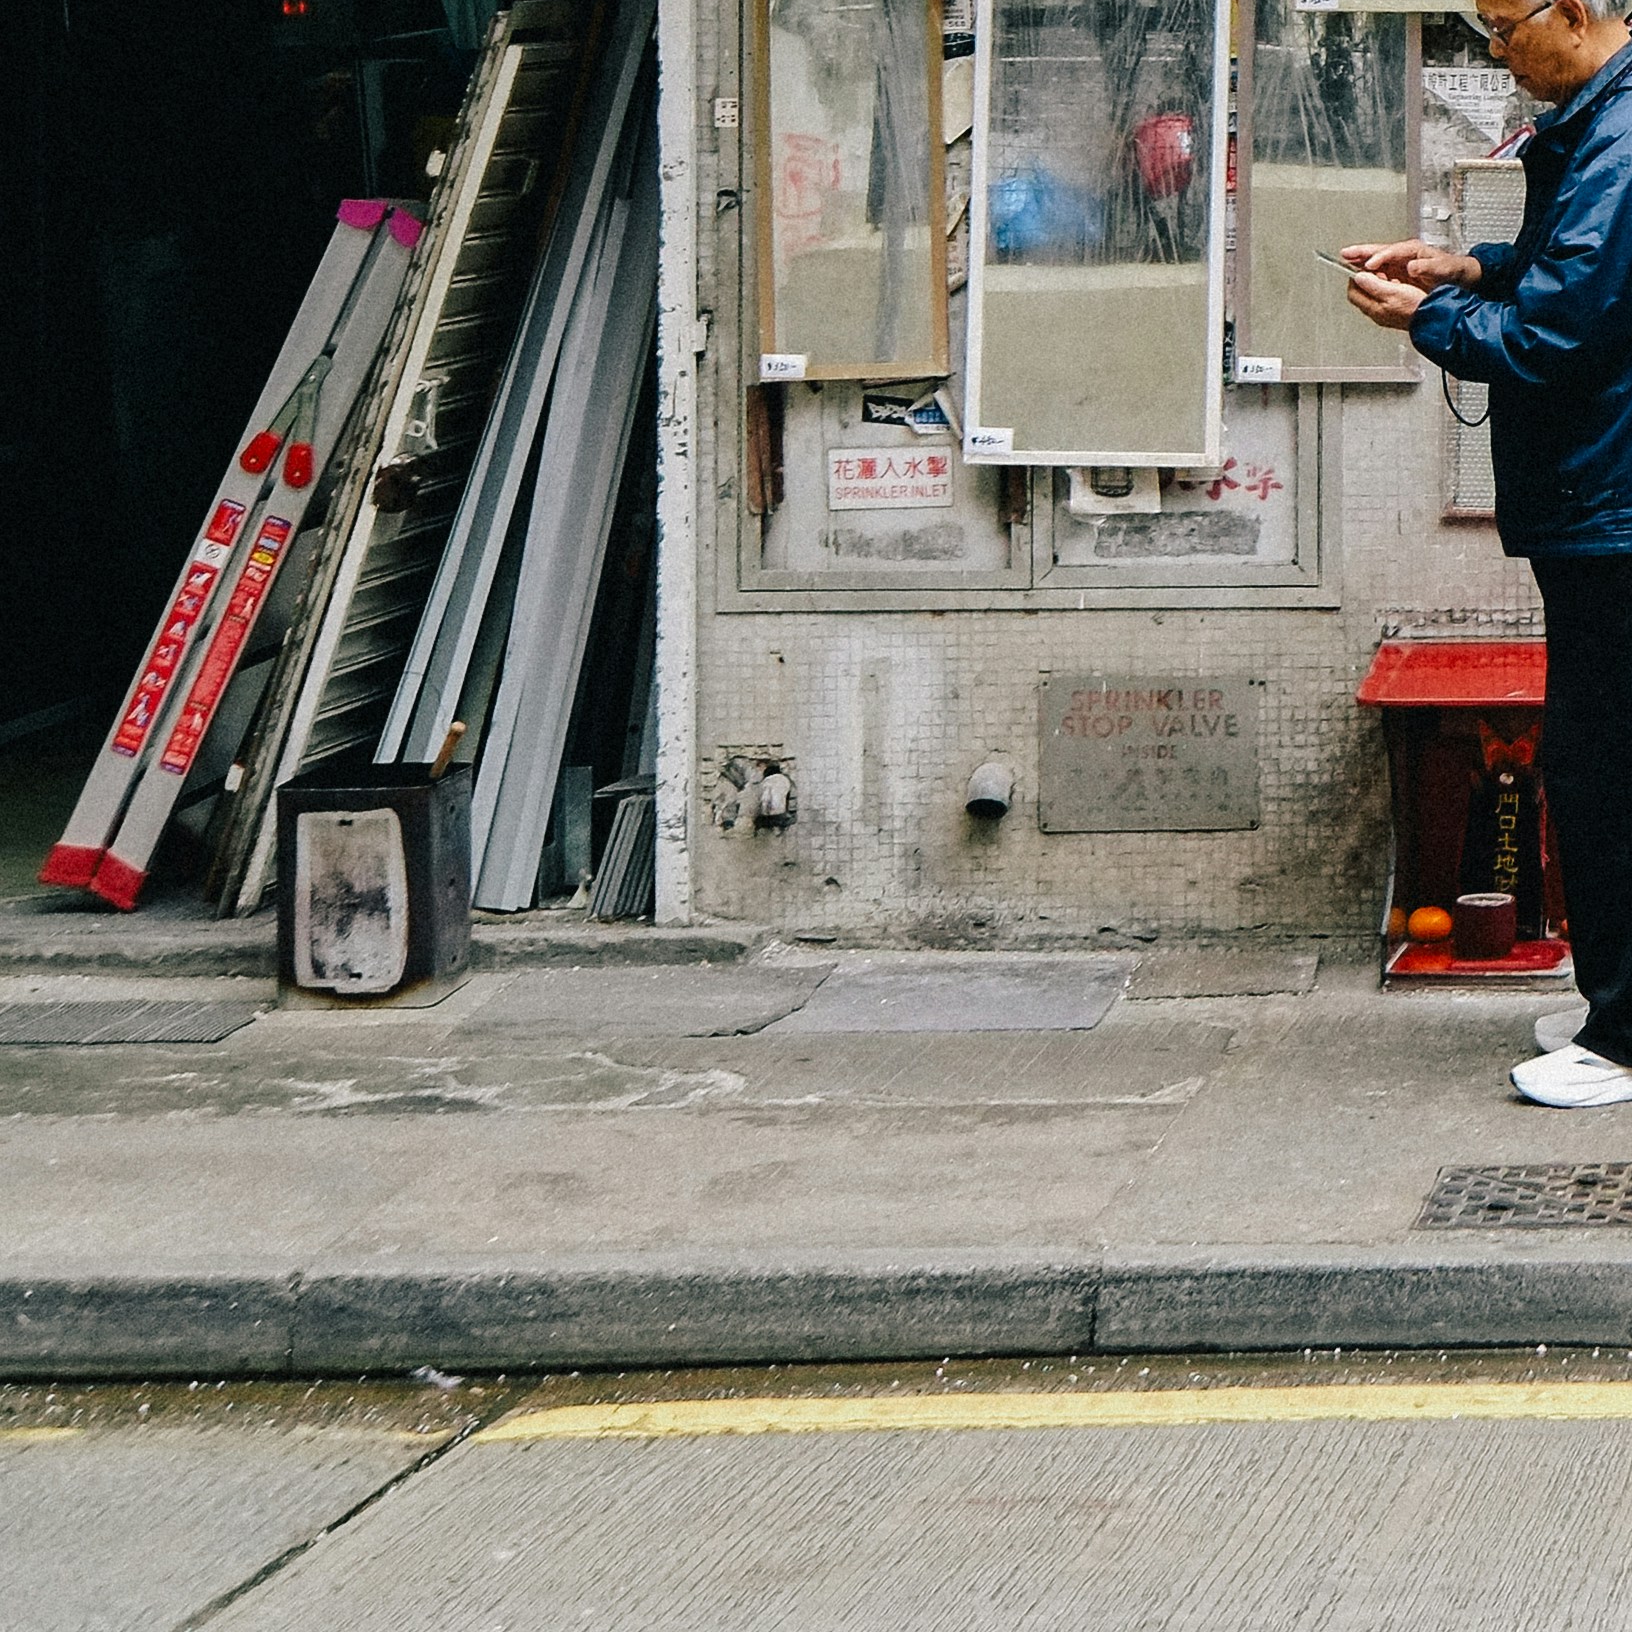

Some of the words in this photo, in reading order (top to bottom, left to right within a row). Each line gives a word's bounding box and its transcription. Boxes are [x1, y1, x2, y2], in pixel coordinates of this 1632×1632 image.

[911, 483, 949, 498] INLET
[1070, 689, 1224, 712] SPRINKLER
[1061, 715, 1134, 738] STOP
[1152, 714, 1239, 737] VALVE
